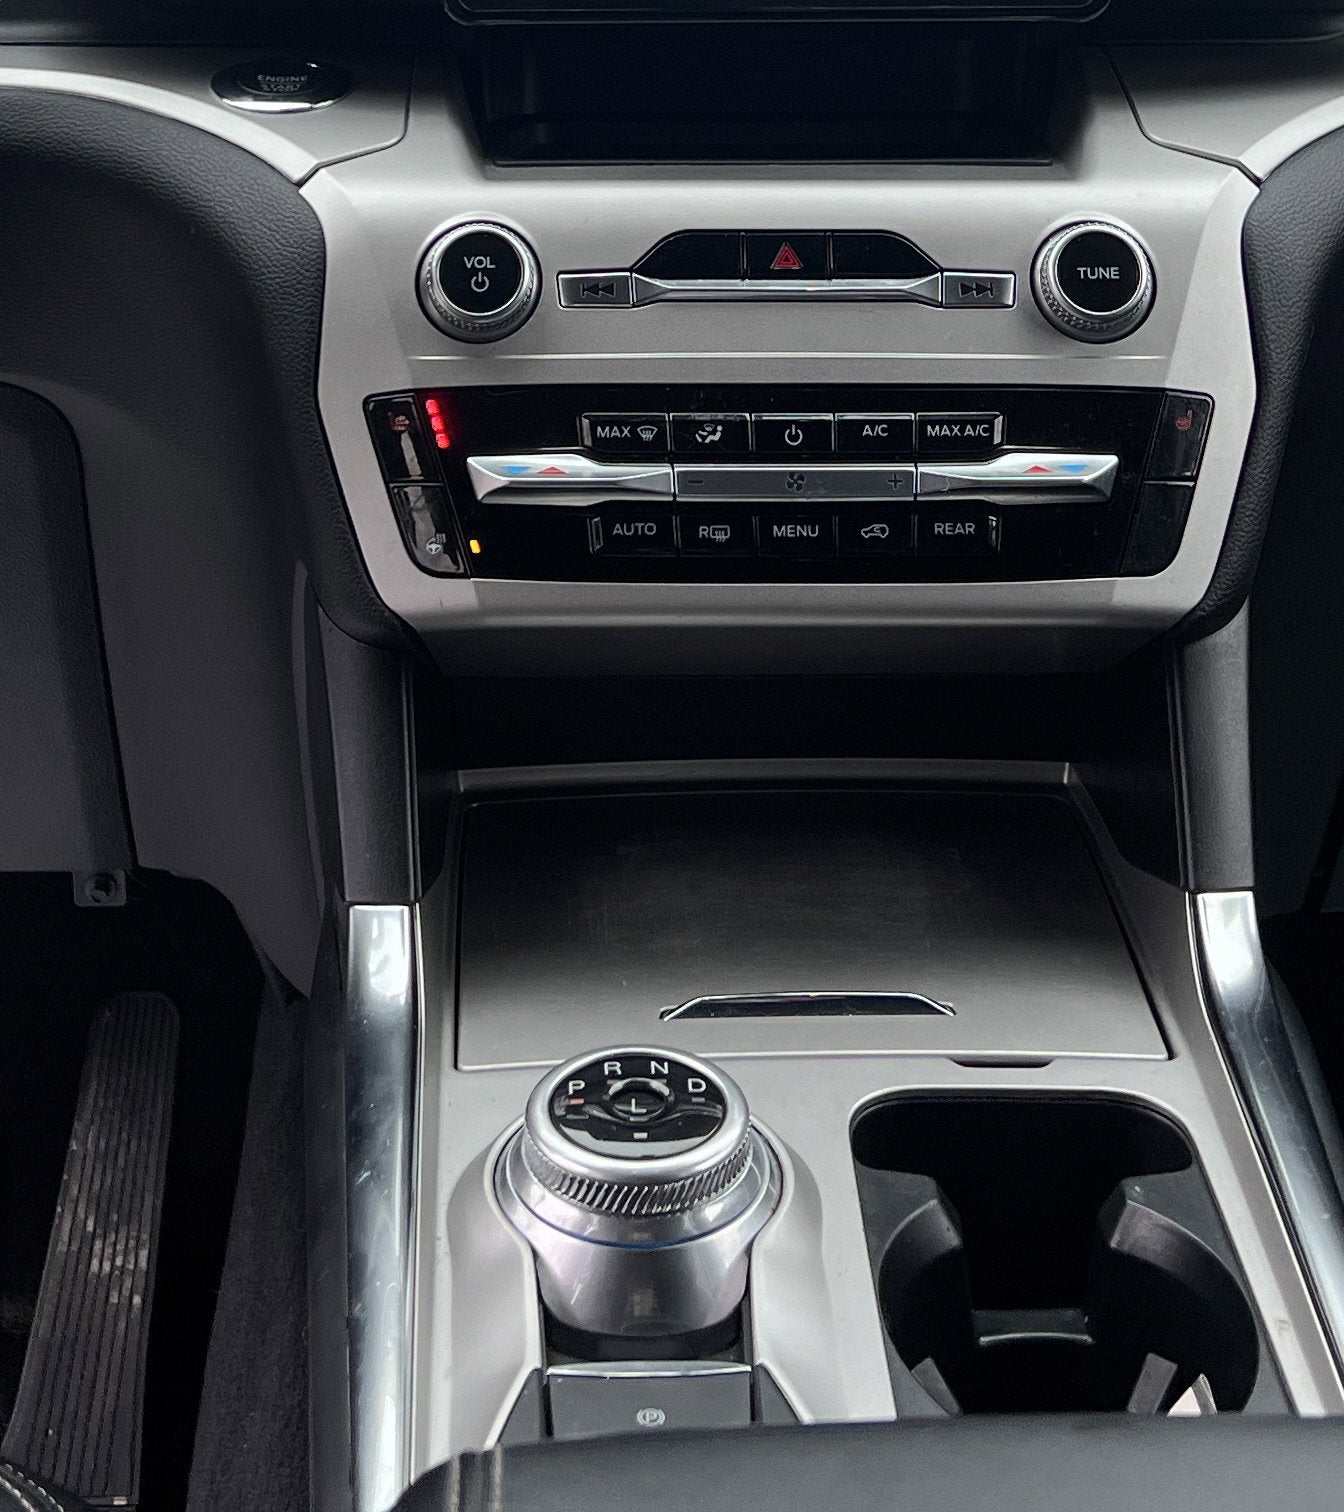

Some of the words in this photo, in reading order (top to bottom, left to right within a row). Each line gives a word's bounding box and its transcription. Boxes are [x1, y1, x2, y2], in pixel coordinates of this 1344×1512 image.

[463, 255, 497, 269] VOL
[1076, 266, 1121, 281] TUNE
[596, 425, 632, 439] MAX
[862, 424, 889, 438] A/C
[926, 425, 961, 438] MAX
[963, 424, 990, 439] A/C
[612, 522, 656, 536] AUTO
[773, 525, 819, 539] MENU
[934, 522, 976, 536] REAR
[604, 1061, 623, 1076] R
[650, 1061, 670, 1076] N
[568, 1080, 586, 1095] P
[688, 1078, 707, 1094] D
